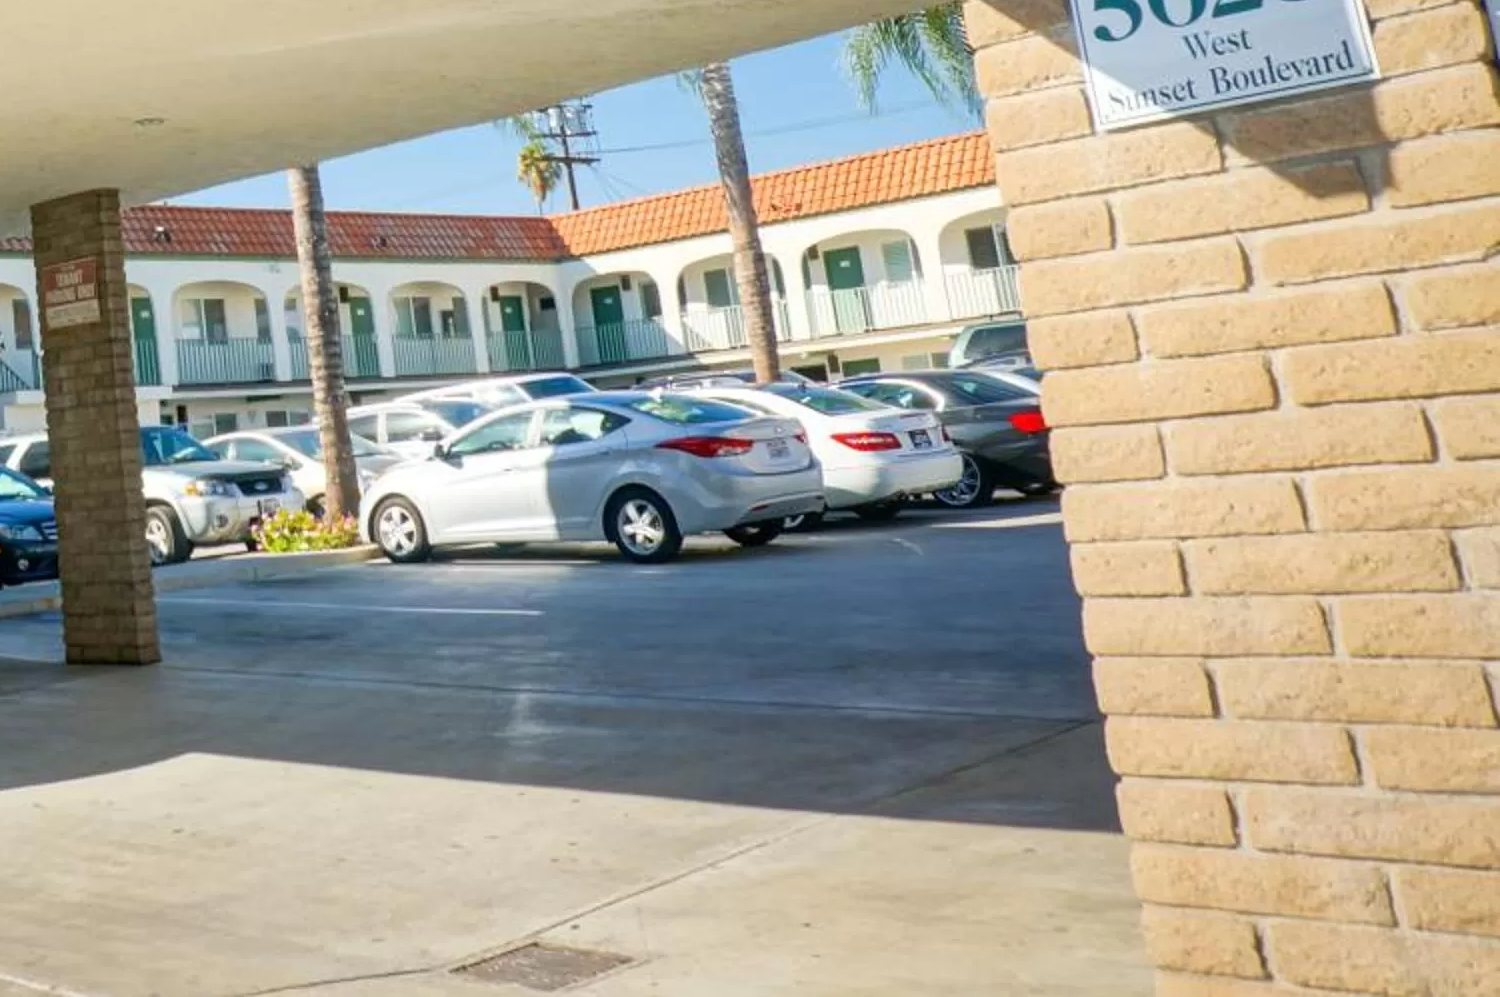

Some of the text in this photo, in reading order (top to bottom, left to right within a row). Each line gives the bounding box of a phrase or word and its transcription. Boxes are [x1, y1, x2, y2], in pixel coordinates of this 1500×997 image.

[1182, 27, 1252, 60] West
[1108, 40, 1355, 115] Sunset Boulevard
